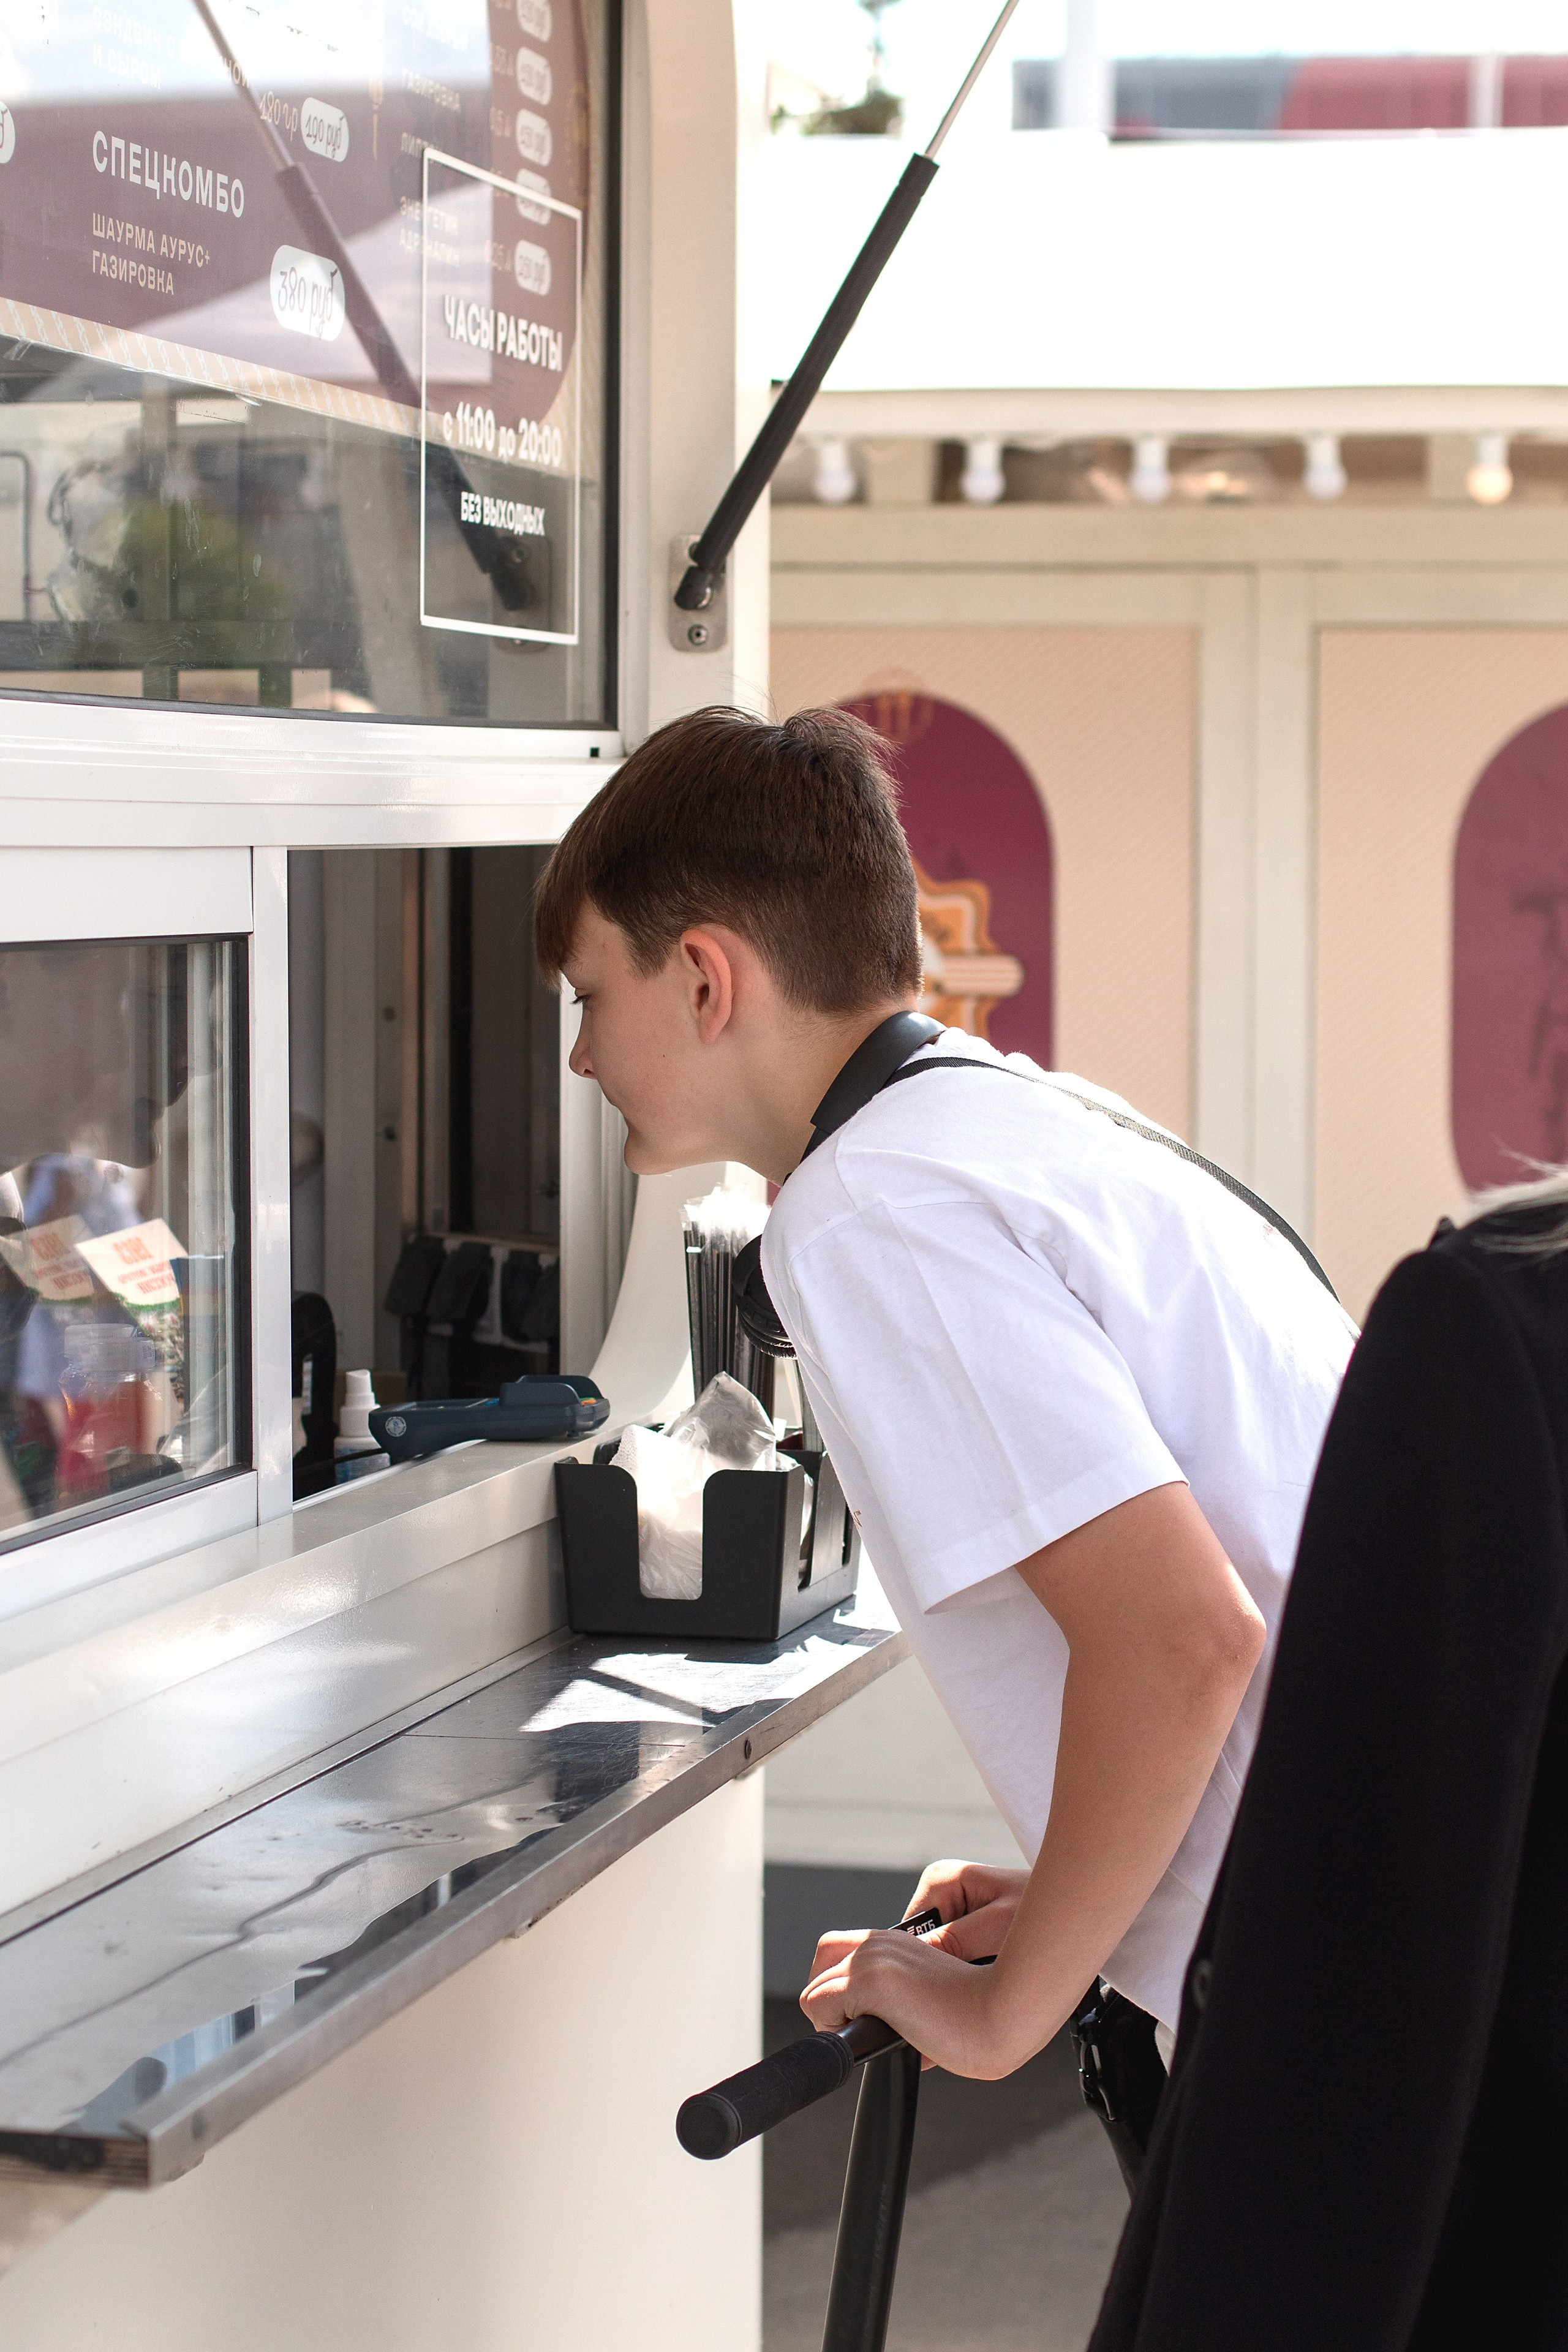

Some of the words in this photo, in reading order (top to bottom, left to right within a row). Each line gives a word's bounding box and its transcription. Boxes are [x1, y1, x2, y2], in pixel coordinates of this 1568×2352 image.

[92, 6, 161, 52] СЭНДВИЧ
[93, 42, 102, 67] И
[108, 49, 161, 89] СЫРОМ
[259, 91, 281, 125] 180
[305, 114, 325, 145] 190
[325, 115, 345, 158] руб
[92, 130, 245, 218] СПЕЦКОМБО
[92, 212, 156, 254] ШАУРМА
[160, 234, 210, 268] АУРУС+
[92, 249, 174, 295] ГАЗИРОВКА
[278, 266, 306, 312] 380
[309, 268, 337, 340] руб
[444, 294, 495, 351] ЧАСЫ
[497, 311, 563, 372] РАБОТЫ
[456, 401, 496, 452] 11:00
[498, 426, 516, 465] до
[518, 418, 562, 467] 20:00
[461, 491, 482, 524] БЕЗ
[483, 496, 546, 537] ВЫХОДНЫХ
[916, 1919, 936, 1935] ВТБ
